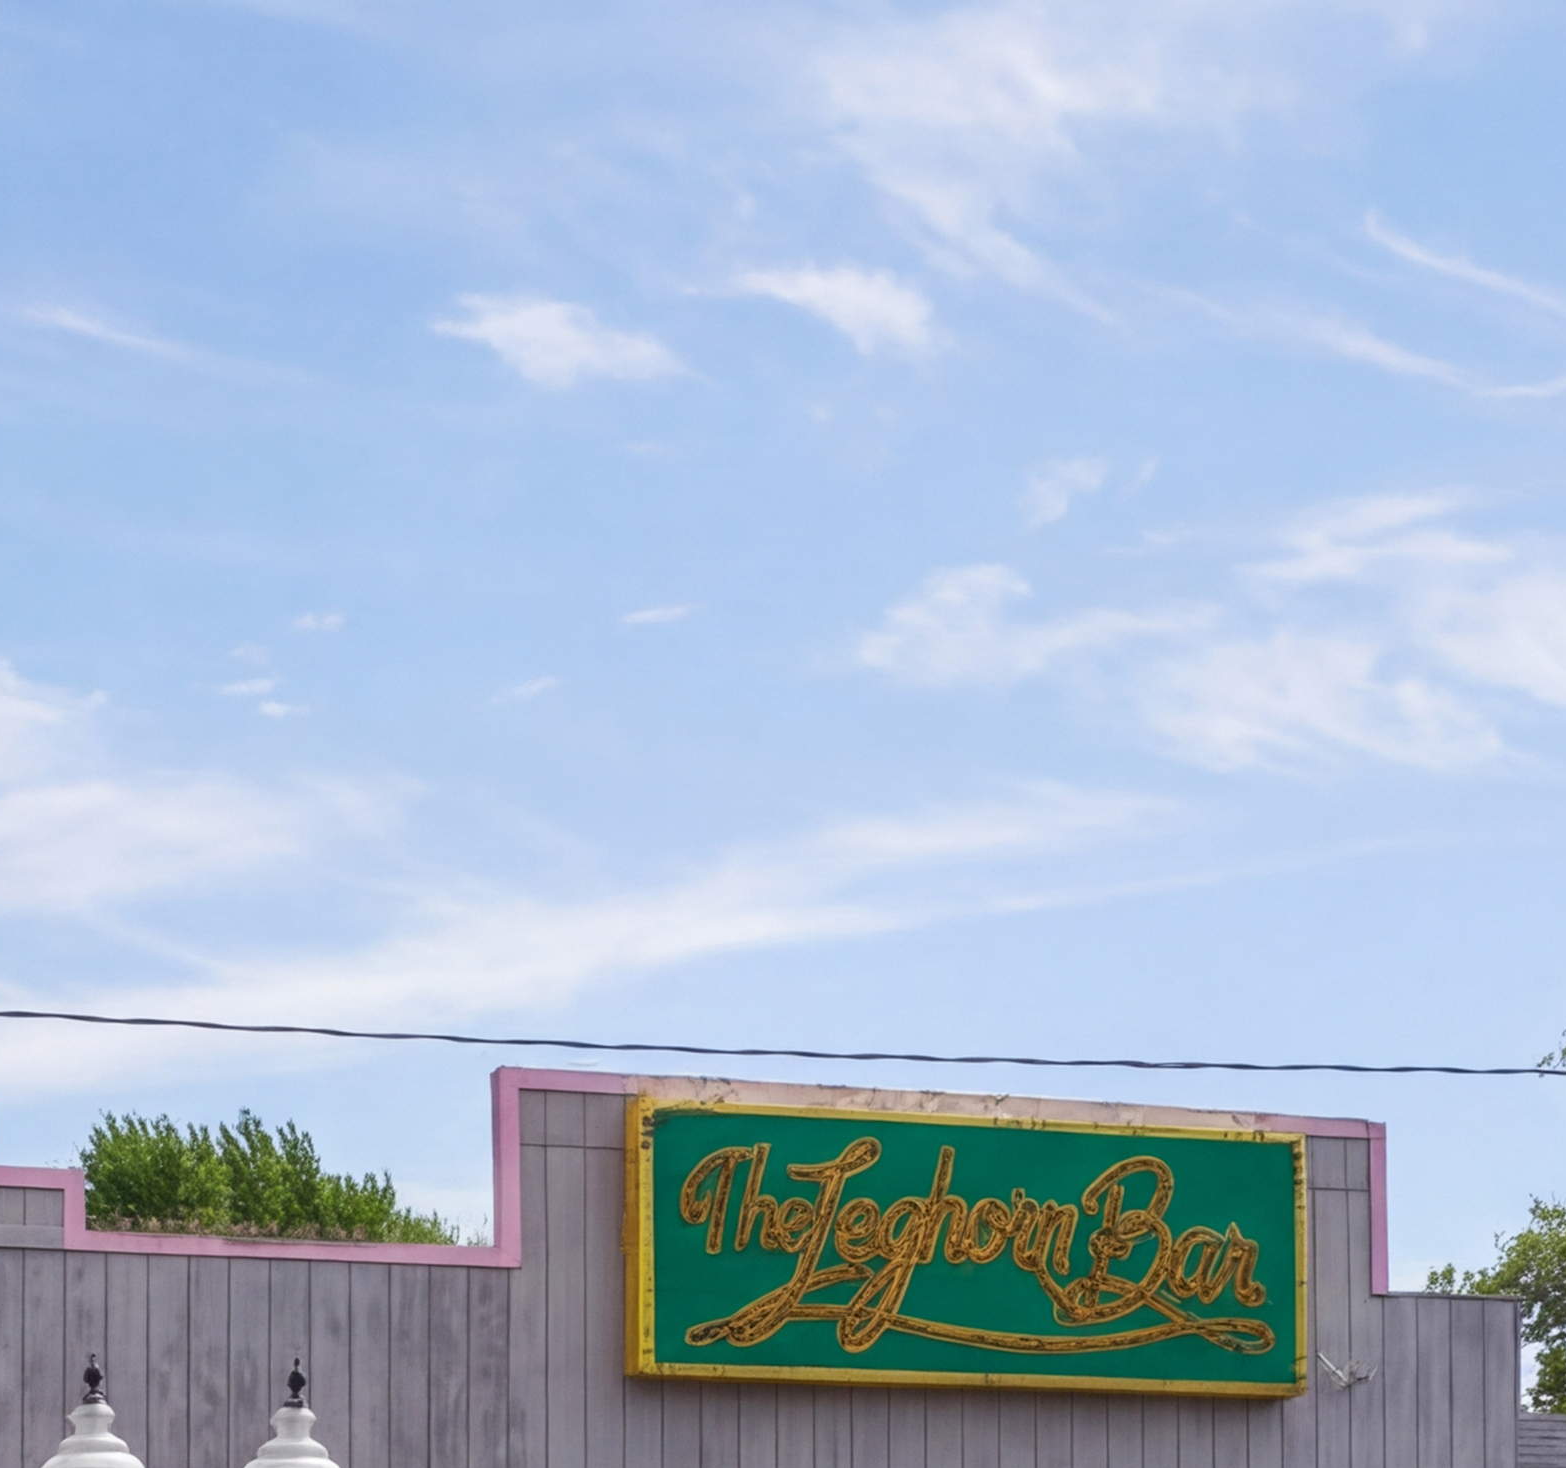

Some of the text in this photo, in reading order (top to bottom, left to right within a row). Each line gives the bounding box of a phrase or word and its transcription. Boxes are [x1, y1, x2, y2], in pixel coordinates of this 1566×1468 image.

[680, 1136, 1266, 1352] The Leghorn Bar
